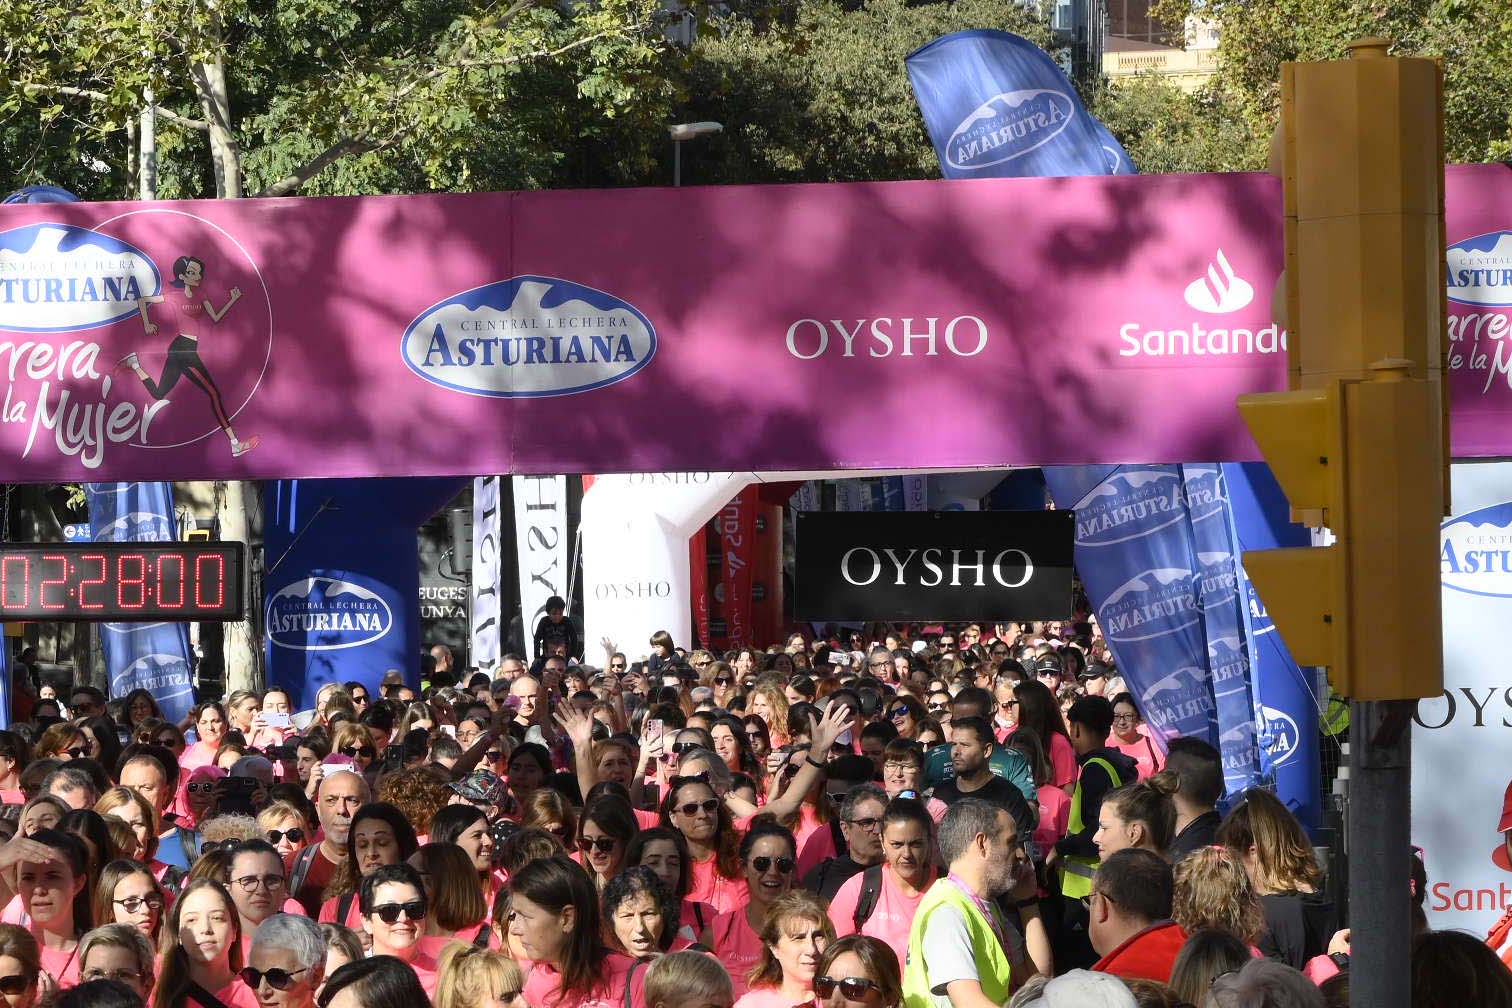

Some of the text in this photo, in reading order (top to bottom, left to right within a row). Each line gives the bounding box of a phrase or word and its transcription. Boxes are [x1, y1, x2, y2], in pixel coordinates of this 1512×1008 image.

[460, 316, 629, 331] CENTRAL LECHERA
[786, 315, 988, 361] OYSHO
[422, 322, 636, 368] ASTURIANA
[1469, 343, 1487, 369] la
[2, 382, 28, 424] la
[22, 372, 172, 469] Mujer
[1, 554, 223, 609] 02:28:00
[839, 547, 1035, 588] OYSHO
[283, 601, 379, 611] CENTRAL LECHERA
[595, 580, 671, 601] OYSHO
[271, 606, 384, 633] ASTURIANA
